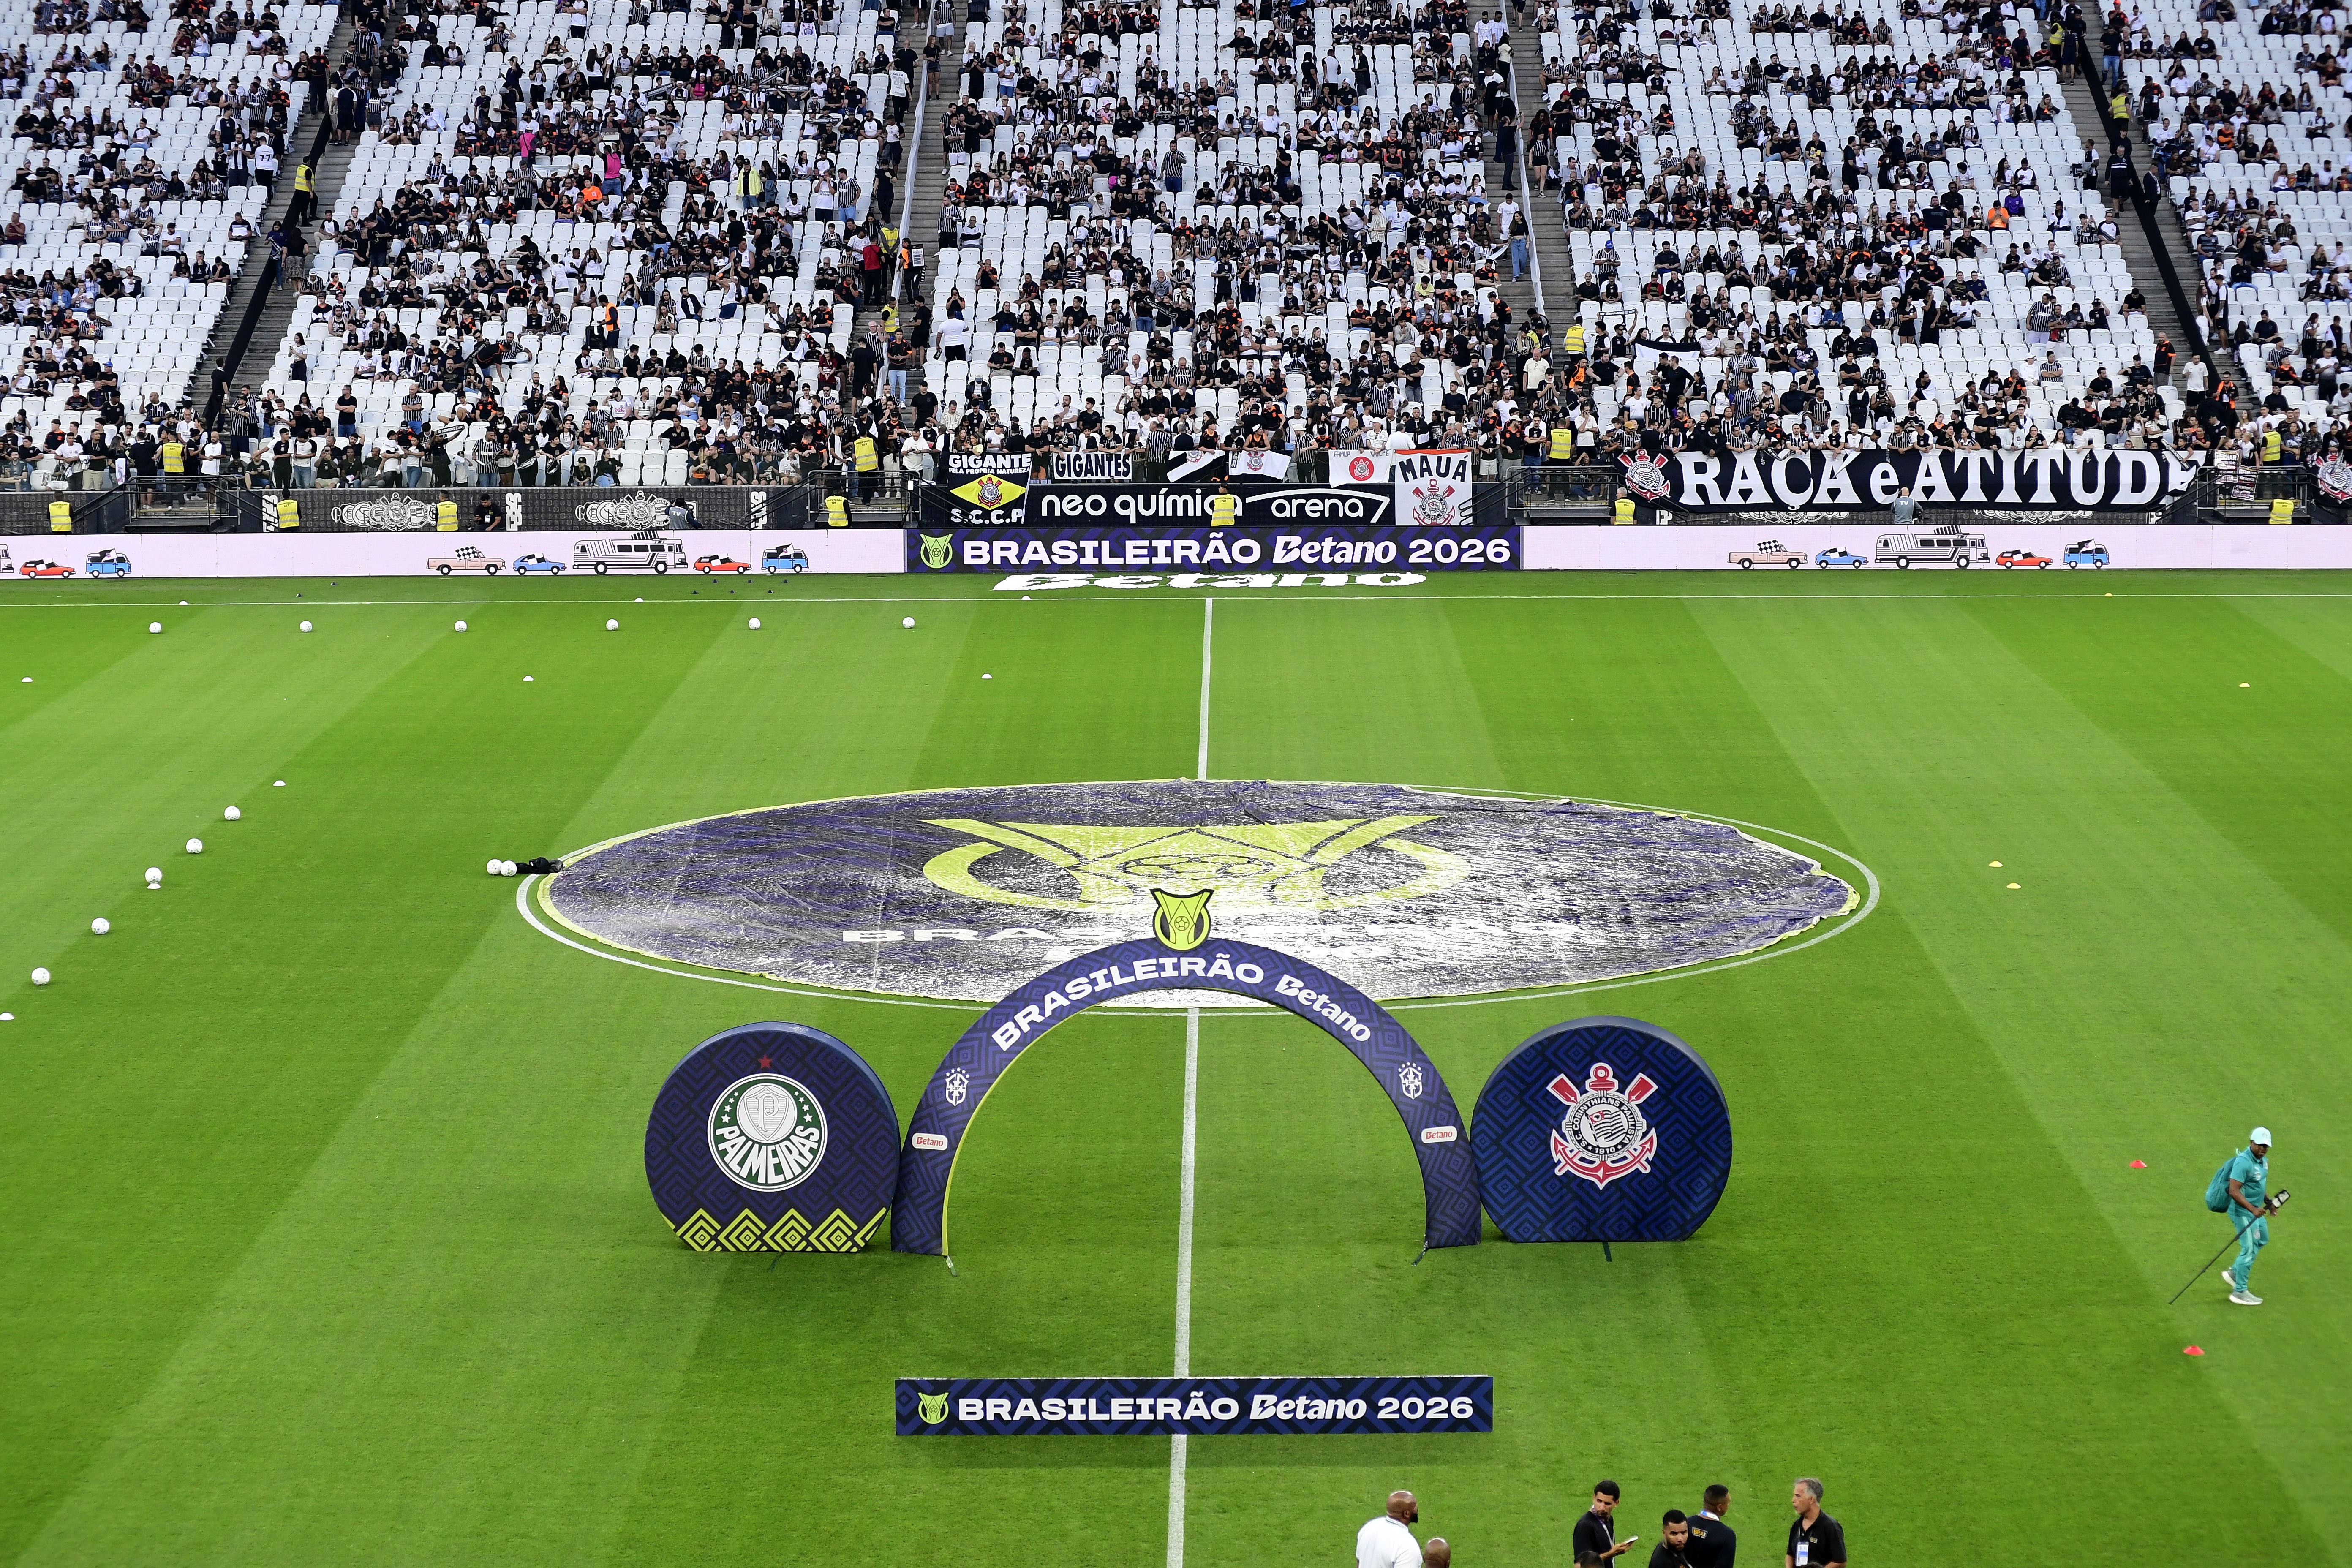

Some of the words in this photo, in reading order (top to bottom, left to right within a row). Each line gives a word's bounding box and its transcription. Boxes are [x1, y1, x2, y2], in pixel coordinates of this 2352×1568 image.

[949, 453, 1032, 468] GIGANTE
[1055, 453, 1130, 478] GIGANTES
[1398, 455, 1468, 483] MAUÁ
[1675, 449, 1862, 510] RAÇA
[1870, 462, 1900, 504] e
[1042, 494, 1107, 517] neo
[1271, 498, 1364, 518] arena
[964, 532, 1261, 565] BRASILEIRÃO
[1272, 536, 1397, 564] Betano
[1409, 539, 1511, 564] 2026
[991, 953, 1264, 1051] BRASILEIRÃO
[1274, 974, 1371, 1042] Betano
[1573, 1097, 1621, 1130] CORINTHIANS
[1620, 1105, 1636, 1144] PAULISTA
[916, 1136, 944, 1147] Betano
[1426, 1131, 1453, 1140] Betano
[716, 1125, 820, 1184] PALMEIRAS
[1594, 1146, 1616, 1154] 1910
[958, 1391, 1239, 1421] BRASILEIRÃO
[1250, 1394, 1367, 1420] Betano
[1377, 1396, 1474, 1420] 2026
